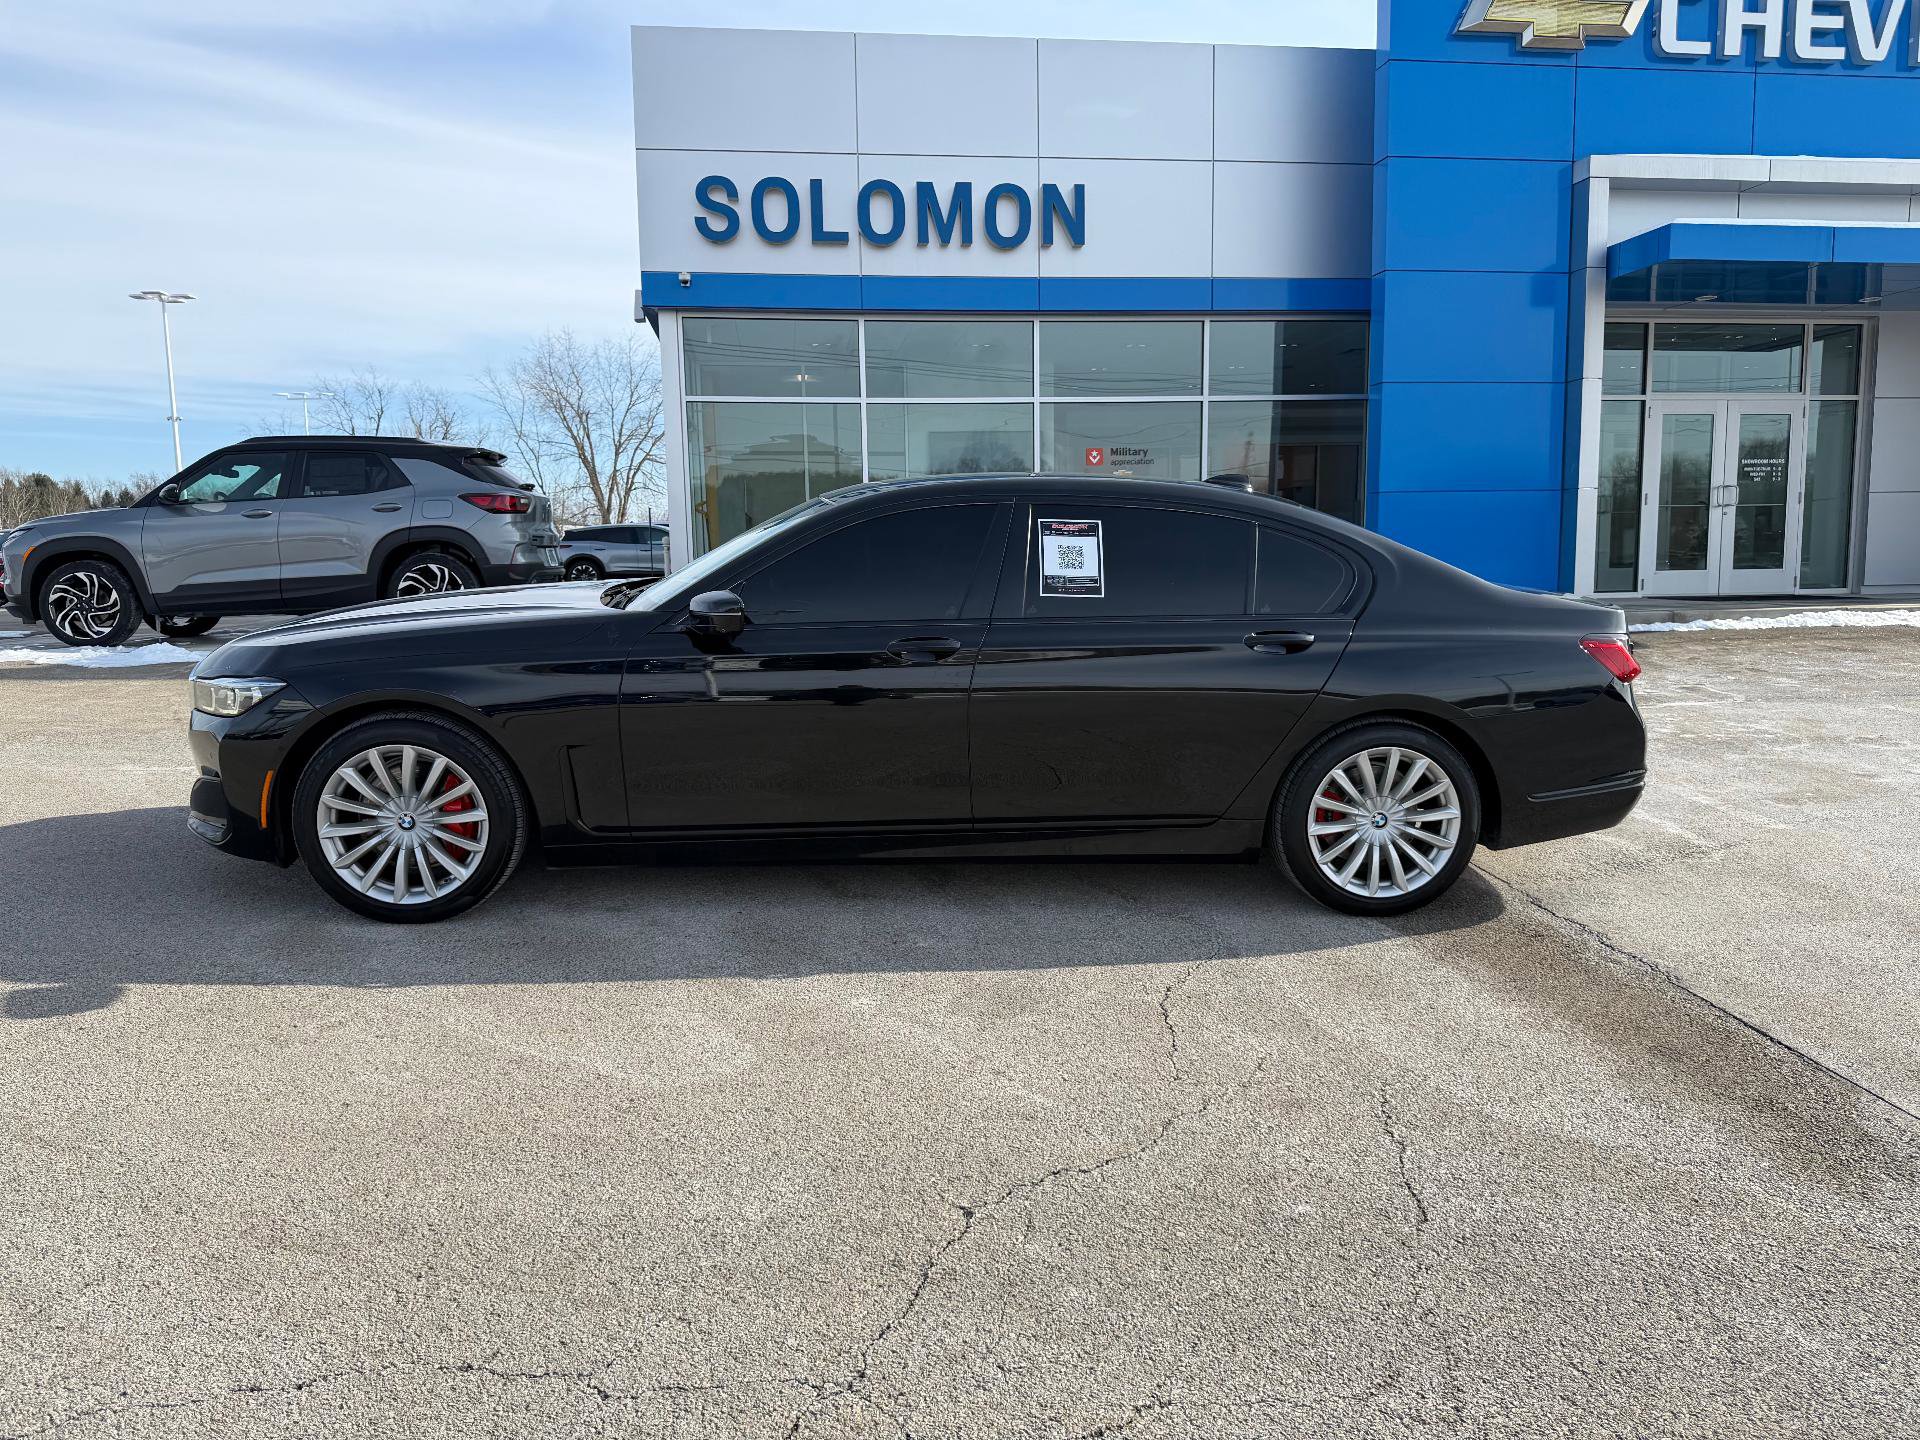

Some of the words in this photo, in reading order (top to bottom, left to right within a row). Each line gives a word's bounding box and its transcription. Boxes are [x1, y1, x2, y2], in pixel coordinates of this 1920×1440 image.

[1656, 0, 1920, 62] CHEV
[694, 175, 1086, 249] SOLOMON
[1110, 447, 1149, 457] Military
[1111, 458, 1155, 466] appreciation
